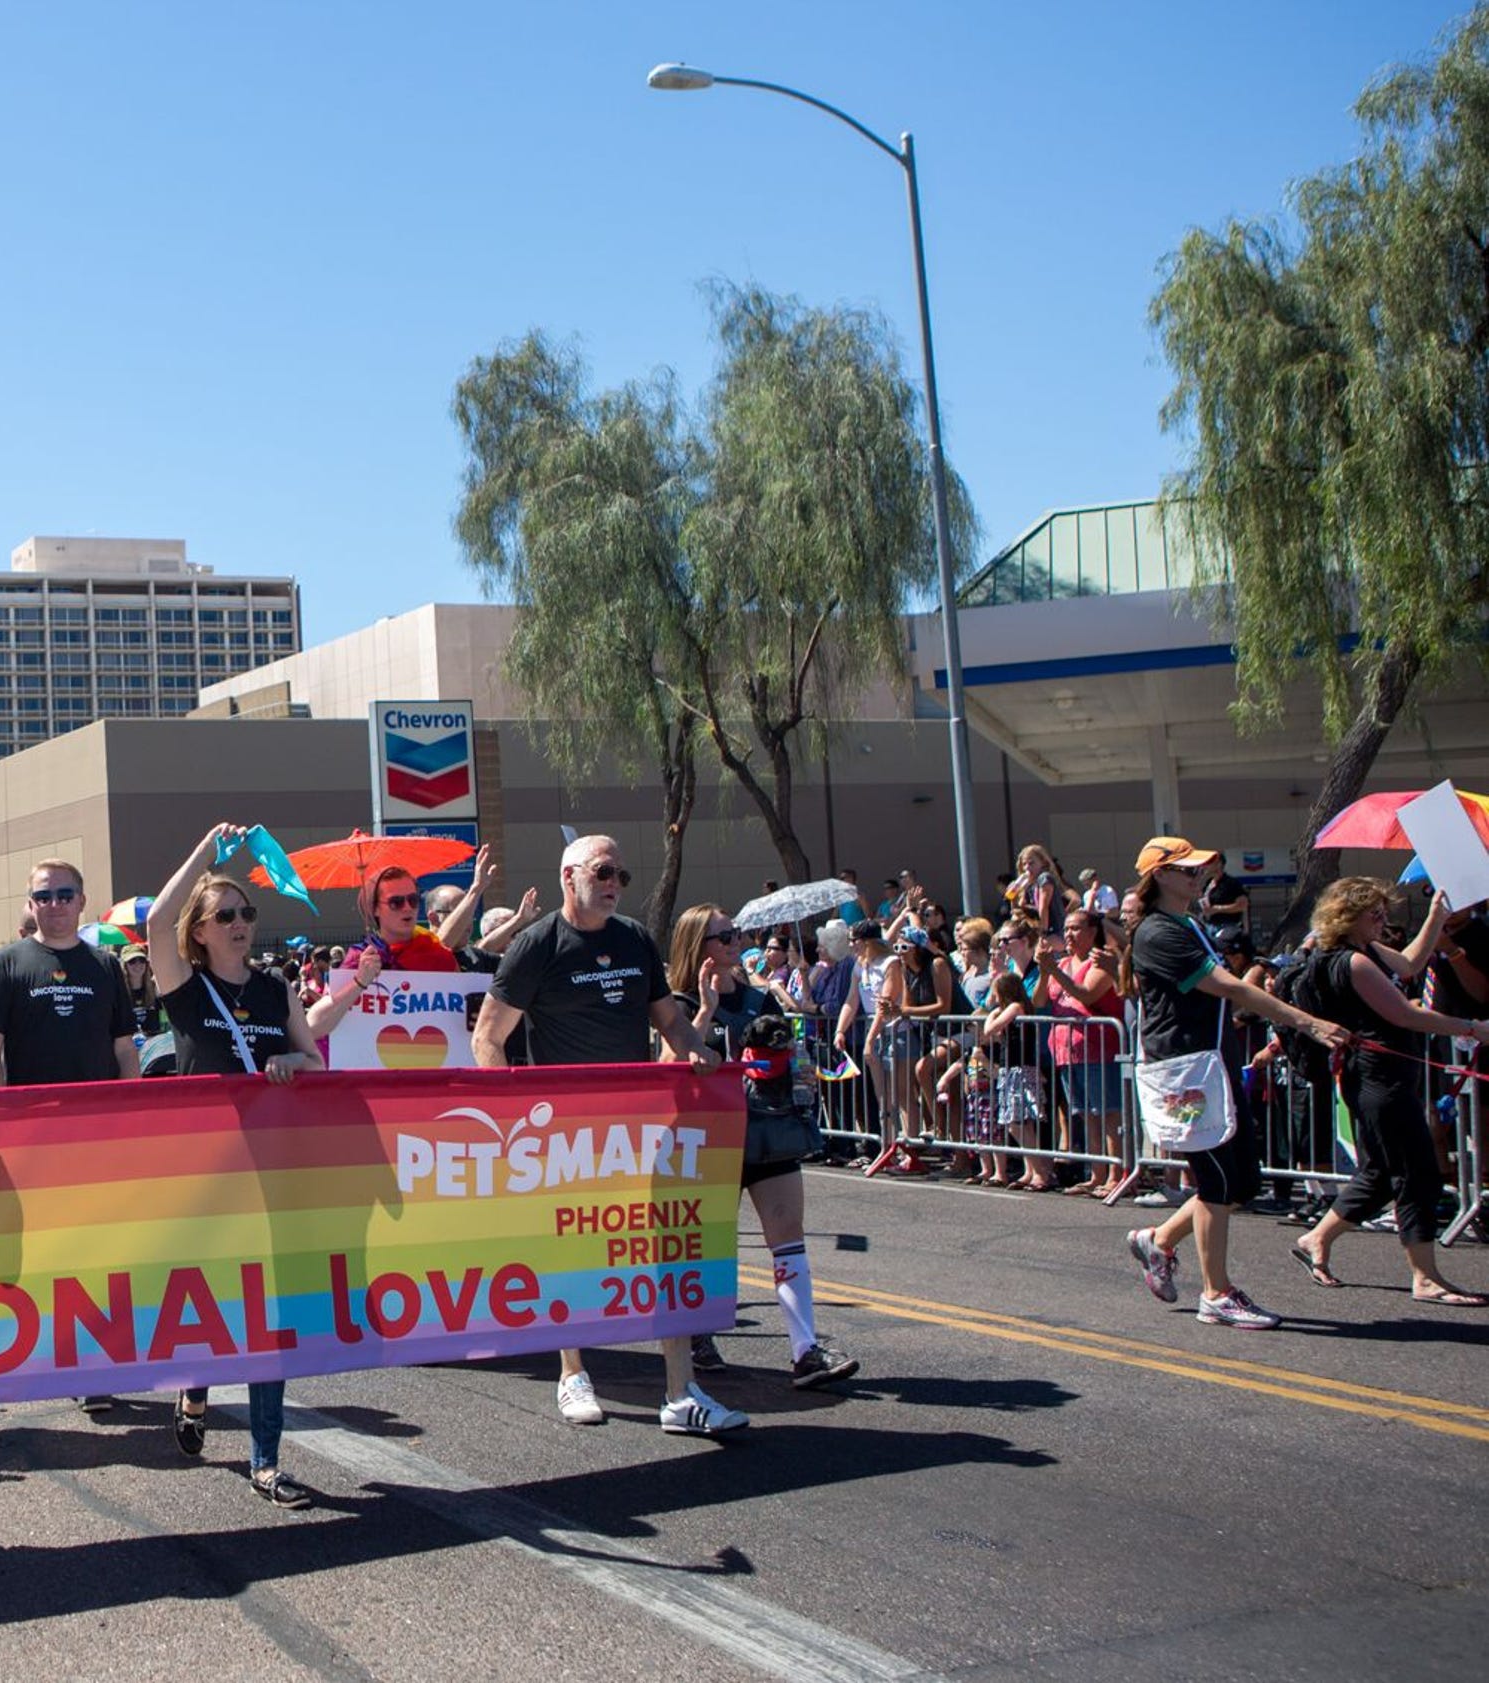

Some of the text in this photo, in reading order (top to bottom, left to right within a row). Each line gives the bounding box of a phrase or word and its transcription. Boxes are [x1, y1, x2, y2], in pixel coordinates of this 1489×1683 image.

[384, 710, 467, 729] Chevron
[571, 967, 643, 984] UNCONDITIONAL
[600, 979, 623, 989] love
[30, 985, 94, 997] UNCONDITIONAL
[53, 993, 73, 1002] love
[348, 991, 467, 1015] ETSMAR
[204, 1018, 284, 1036] UNCODITIONAL
[396, 1124, 706, 1197] PETSMART
[555, 1199, 703, 1237] PHOENIX
[606, 1232, 703, 1267] PRIDE
[329, 1252, 570, 1345] love.
[599, 1269, 705, 1318] 2016
